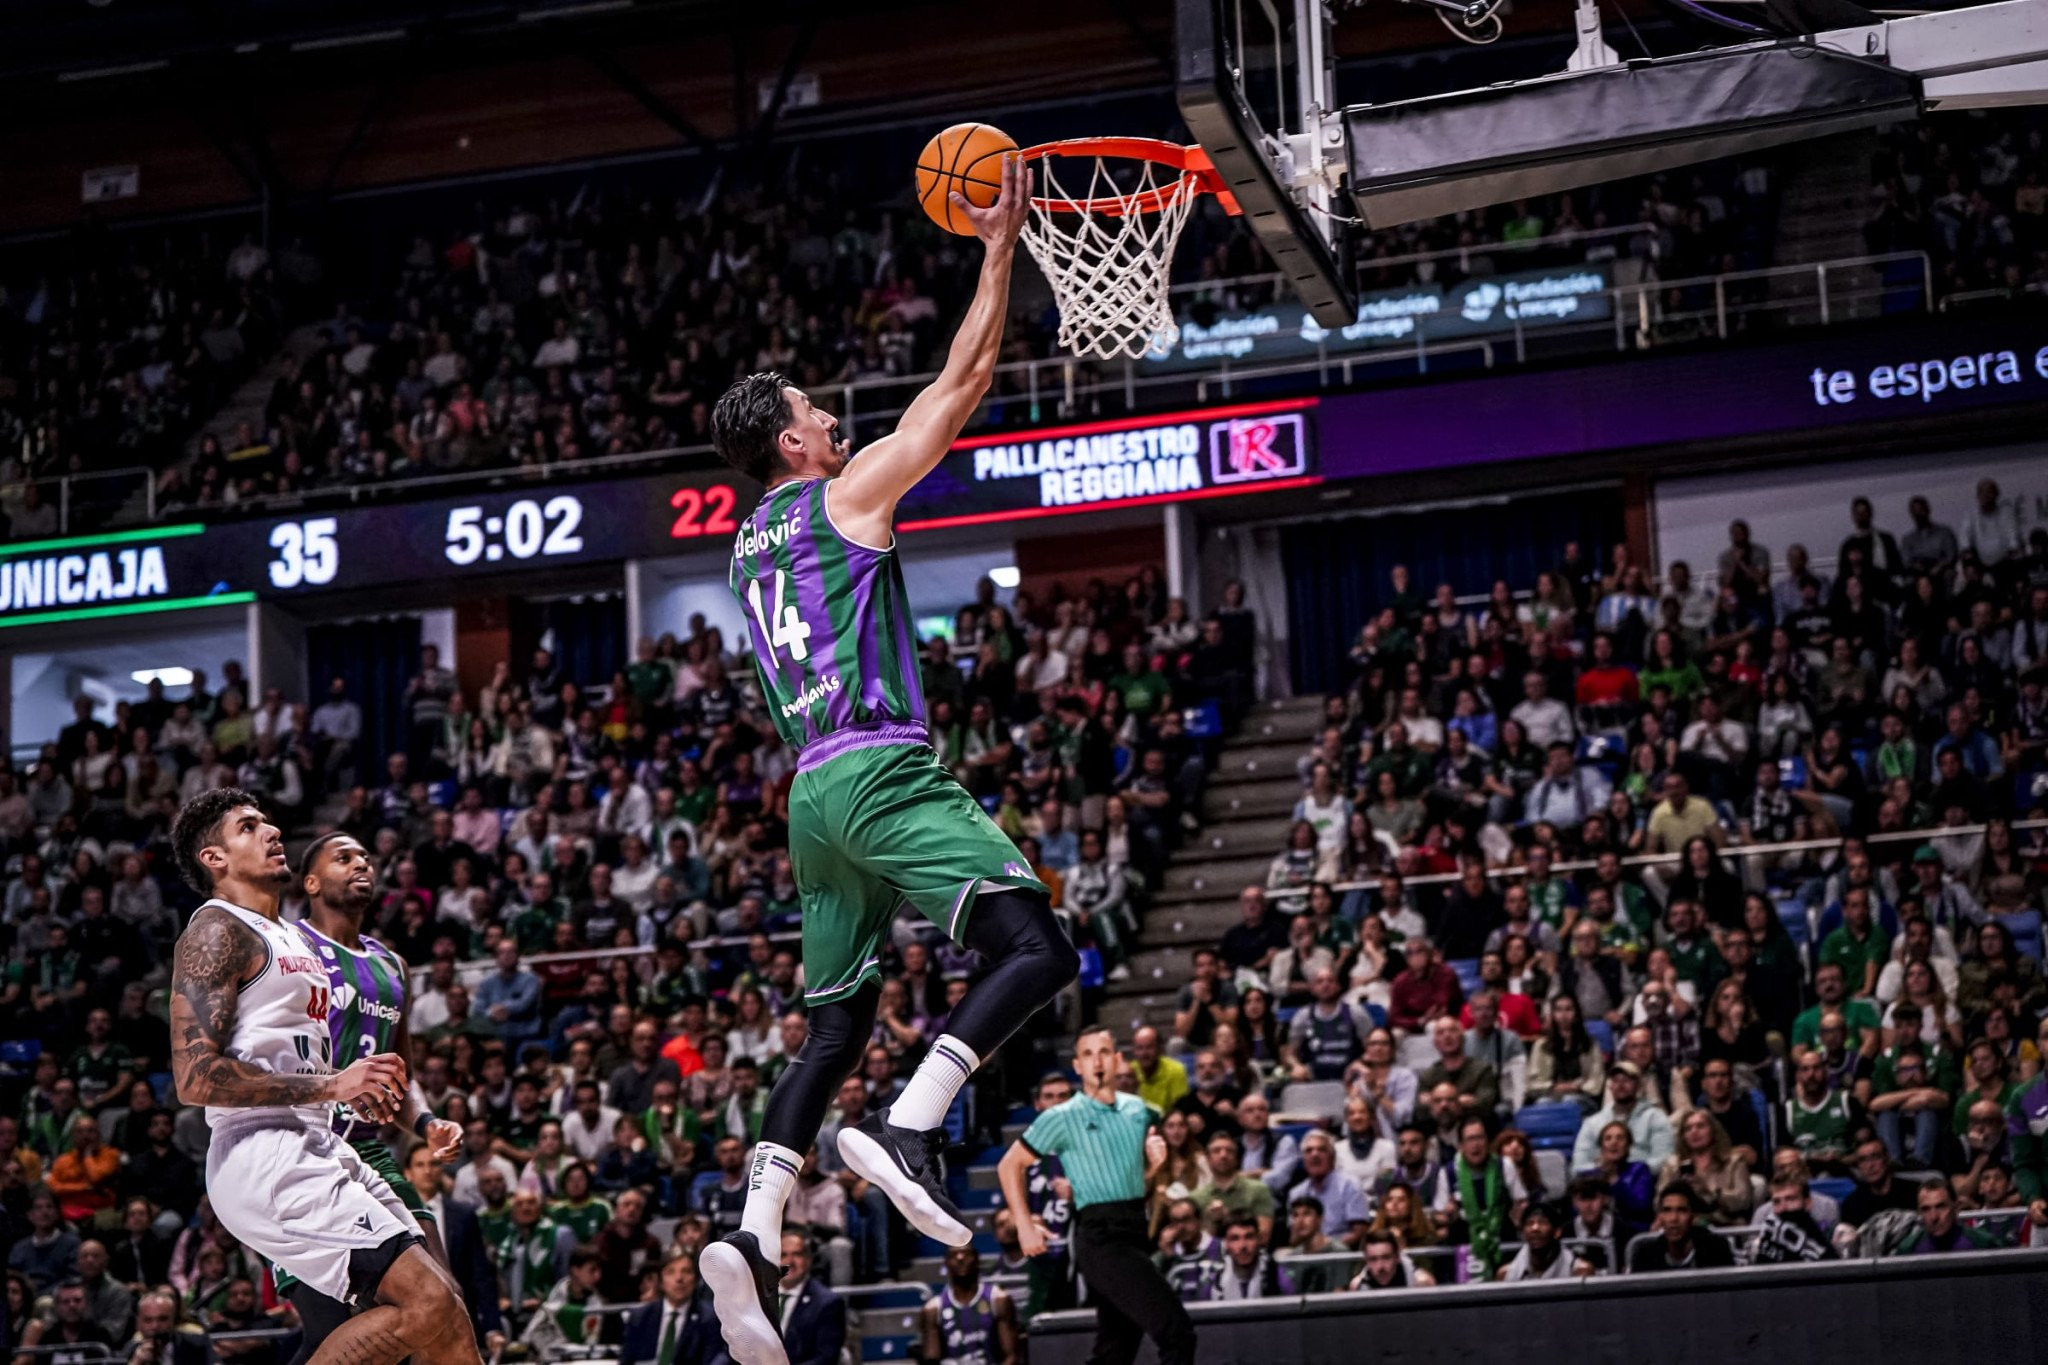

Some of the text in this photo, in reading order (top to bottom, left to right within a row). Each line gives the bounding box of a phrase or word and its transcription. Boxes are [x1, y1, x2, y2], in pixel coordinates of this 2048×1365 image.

[1809, 367, 1856, 406] te
[1868, 350, 2022, 403] espera
[974, 424, 1200, 482] PALLACANESTRO
[1040, 456, 1202, 507] REGGIANA
[445, 495, 584, 565] 5:02
[670, 485, 736, 538] 22
[268, 517, 339, 588] 35
[748, 569, 811, 669] 14
[751, 1152, 770, 1191] UNICAJA
